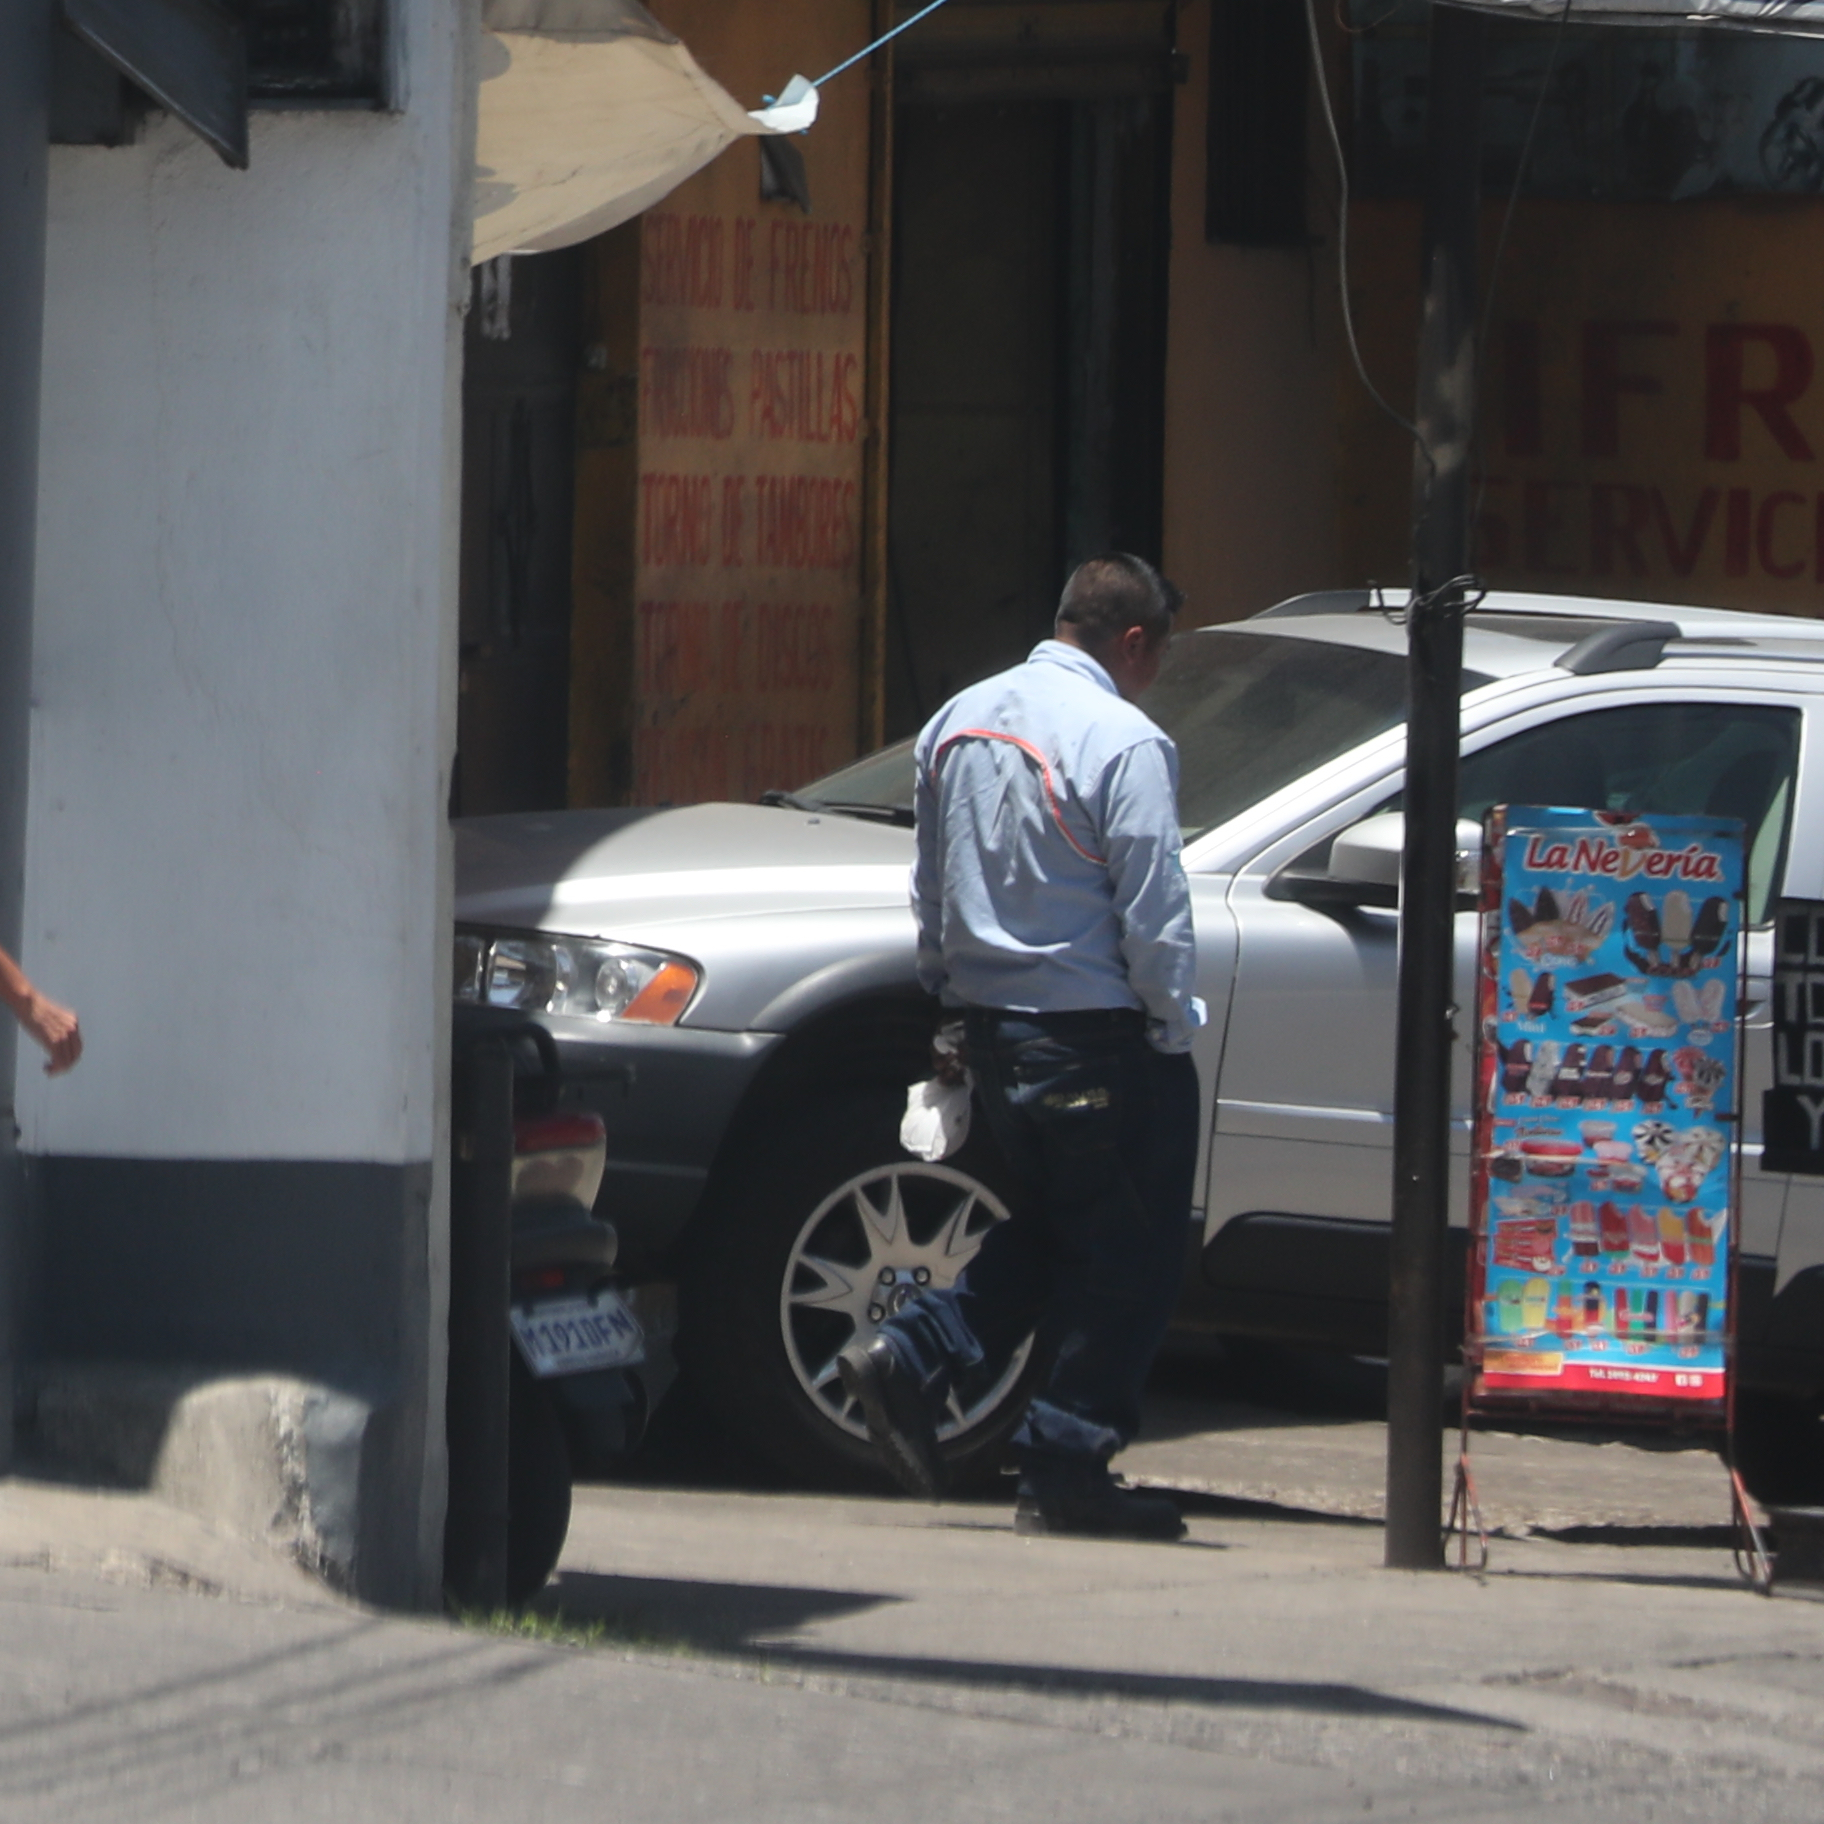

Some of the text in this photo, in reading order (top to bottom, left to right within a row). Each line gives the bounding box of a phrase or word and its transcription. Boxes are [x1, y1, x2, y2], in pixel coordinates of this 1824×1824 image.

[733, 215, 756, 312] DE
[767, 218, 853, 315] FRENOS
[753, 348, 859, 443] PASTILLAS
